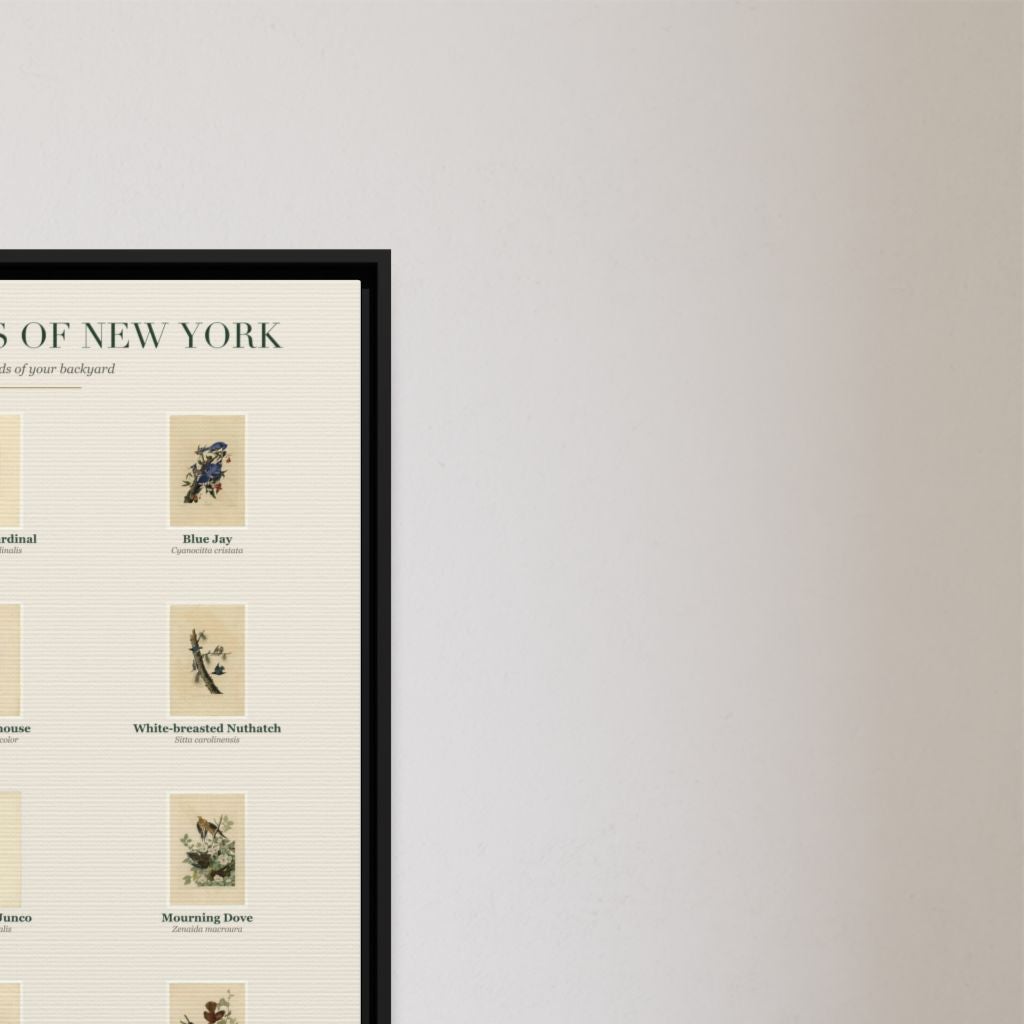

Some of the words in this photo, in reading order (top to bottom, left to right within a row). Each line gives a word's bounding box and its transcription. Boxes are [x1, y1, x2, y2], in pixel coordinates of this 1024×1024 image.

[20, 321, 72, 349] OF
[82, 321, 169, 349] NEW
[178, 321, 284, 349] YORK
[14, 363, 29, 377] of
[29, 366, 57, 377] your
[59, 363, 116, 377] backyard
[182, 533, 210, 544] Blue
[211, 534, 233, 547] Jay
[132, 722, 224, 733] White-breasted
[226, 722, 281, 733] Nuthatch
[161, 912, 221, 925] Mourning
[223, 912, 254, 923] Dove
